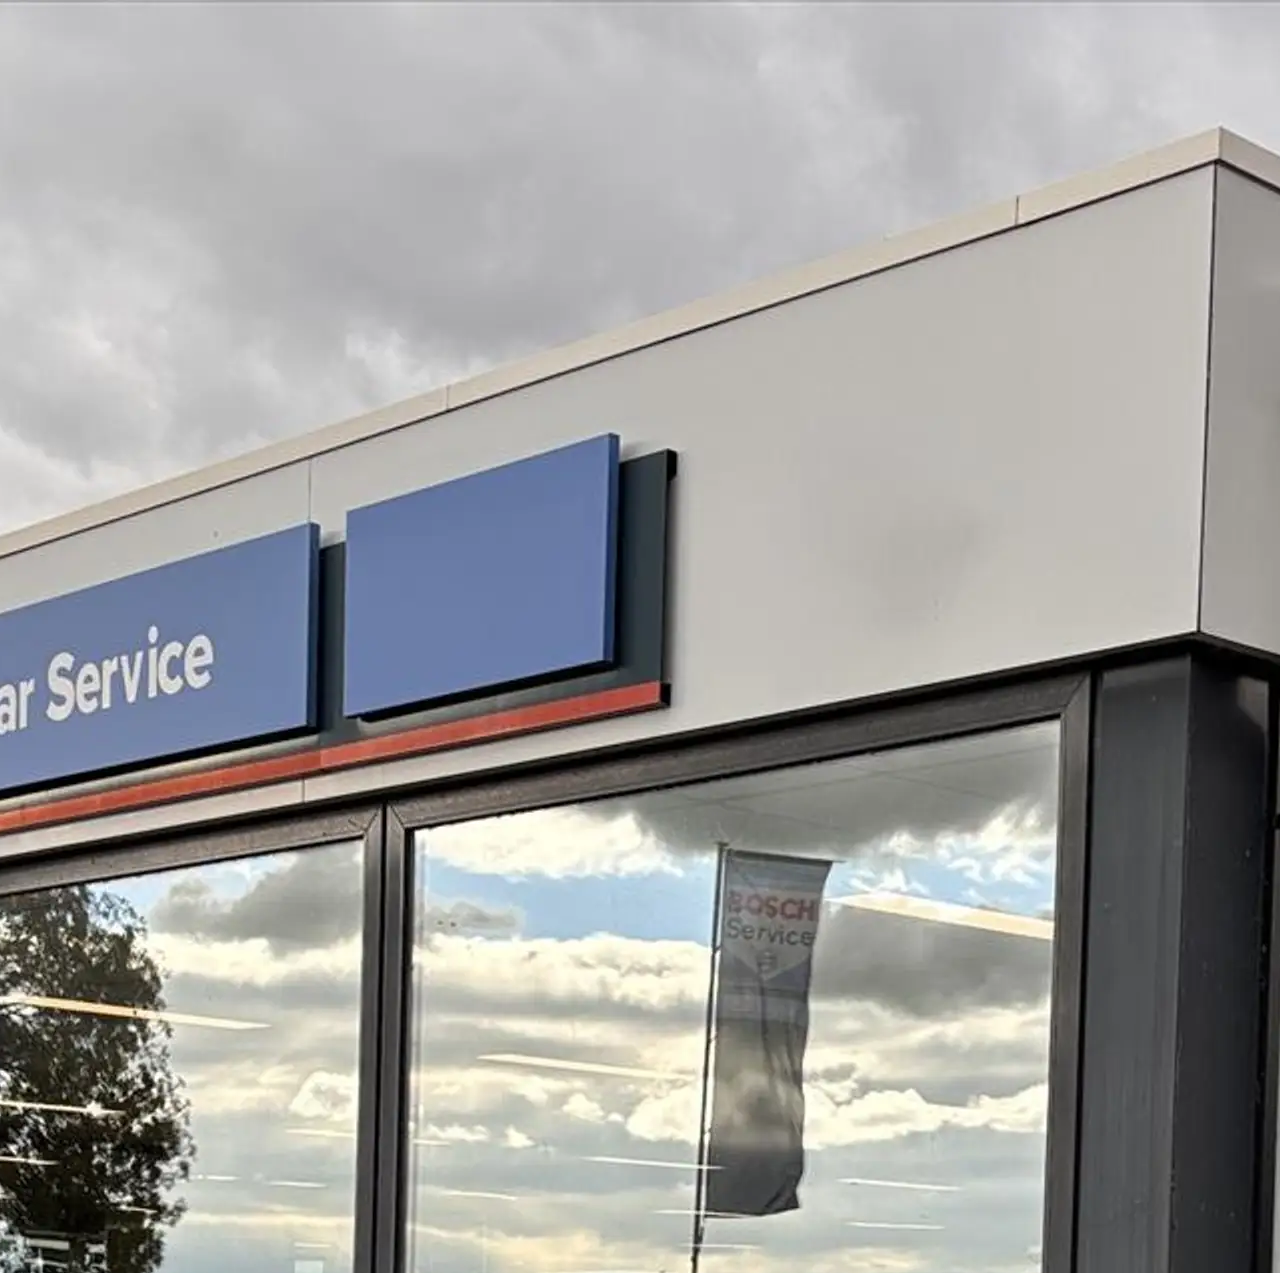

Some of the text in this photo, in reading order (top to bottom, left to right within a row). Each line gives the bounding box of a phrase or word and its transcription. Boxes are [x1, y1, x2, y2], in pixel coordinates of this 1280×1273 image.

[46, 626, 213, 721] Service
[728, 890, 815, 921] BOSCH
[726, 917, 817, 946] Service
